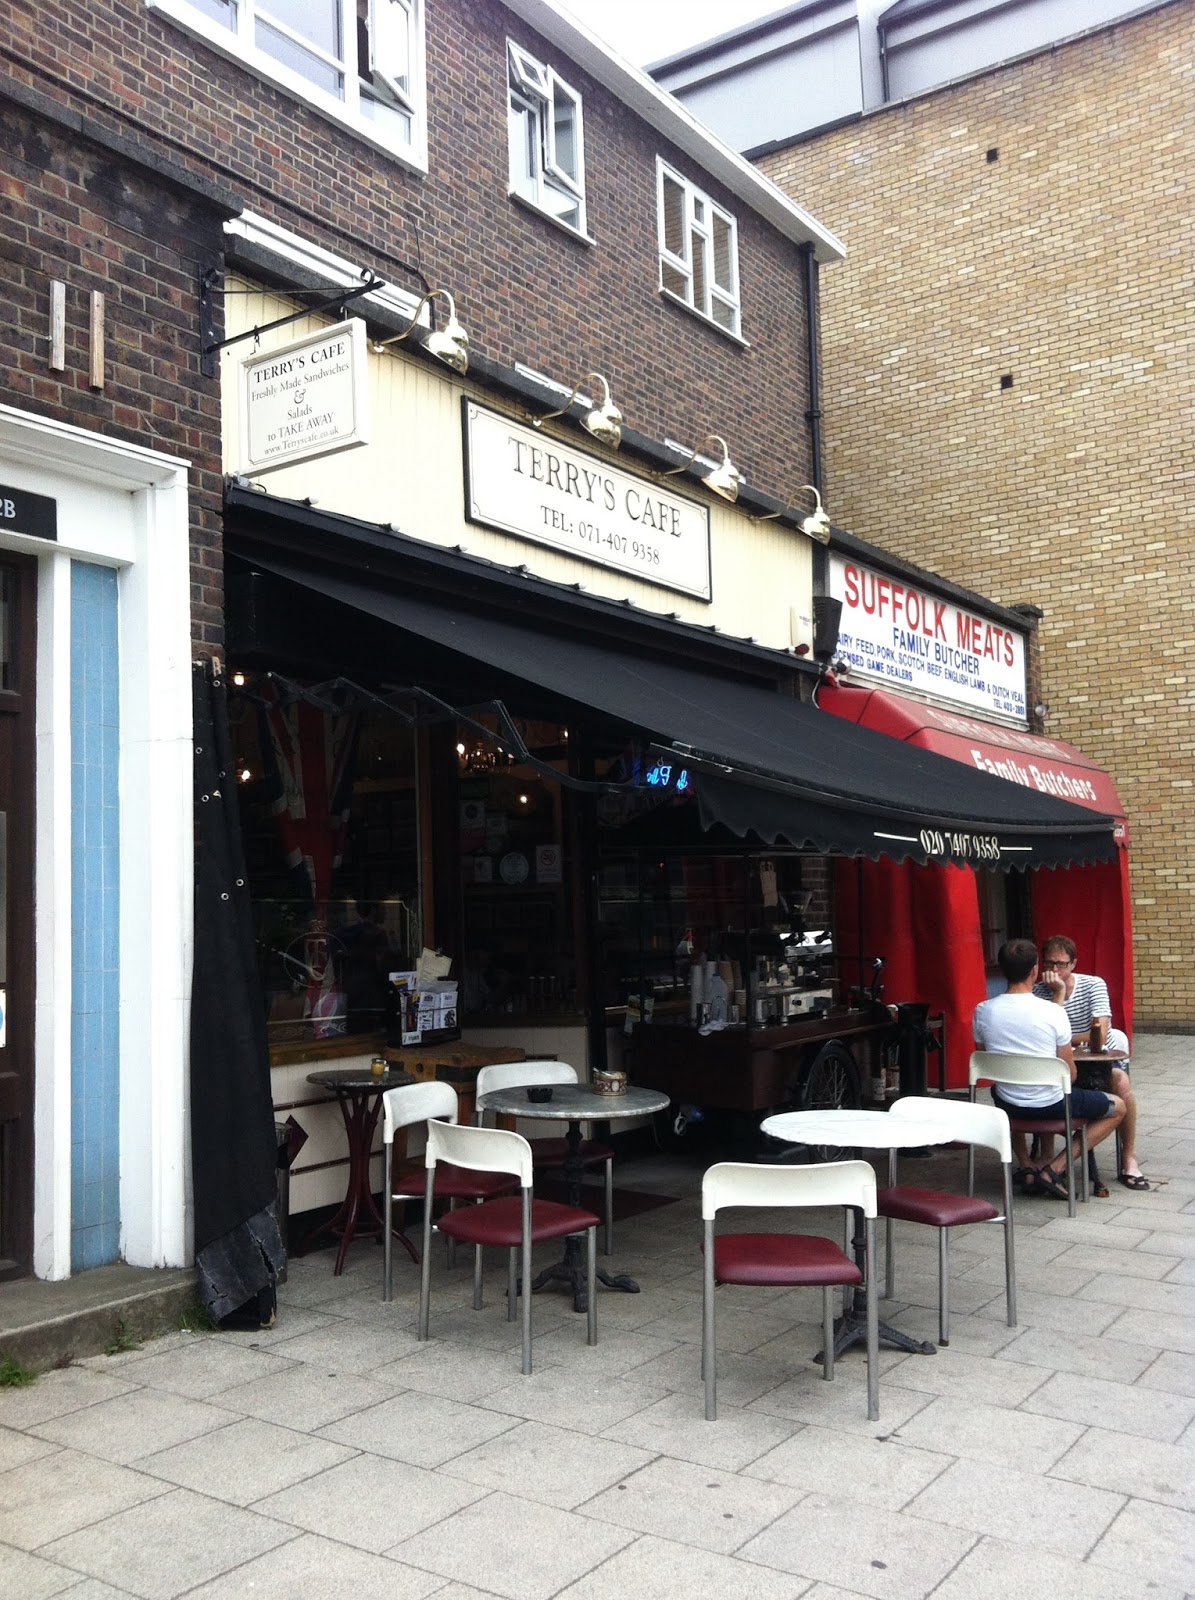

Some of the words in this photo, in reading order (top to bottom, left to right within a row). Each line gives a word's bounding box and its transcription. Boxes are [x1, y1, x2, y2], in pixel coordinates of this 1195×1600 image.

[251, 385, 279, 402] Freshly
[280, 376, 303, 392] Made
[303, 362, 350, 384] Sandwiches
[253, 355, 306, 383] TERRY'S
[310, 341, 346, 364] CAFE
[287, 403, 313, 421] Salads
[293, 388, 307, 405] &
[267, 433, 277, 443] to
[277, 420, 305, 439] TAKE
[306, 411, 335, 431] AWAY
[507, 435, 616, 512] TERRY'S
[624, 488, 683, 539] CAFE
[0, 497, 16, 519] B
[540, 504, 574, 534] TEL:
[577, 520, 628, 555] 071-407
[631, 540, 661, 566] 9358
[843, 563, 948, 643] SUFFOLK
[956, 610, 1015, 668] MEATS
[837, 632, 854, 649] AIRY
[898, 651, 925, 673] SCOTCH
[944, 667, 969, 687] ENGLISH
[969, 676, 986, 693] LAMB
[992, 683, 1010, 700] DUTCH
[1010, 689, 1025, 705] VEAL
[866, 657, 885, 675] GAME
[886, 663, 913, 682] DEALERS
[892, 626, 931, 659] FAMILY
[934, 641, 981, 677] BUTCHER
[970, 749, 1031, 787] Family
[1027, 764, 1097, 801] Butchers
[920, 829, 945, 855] 020
[944, 832, 971, 857] 7407
[972, 835, 1001, 860] 9358
